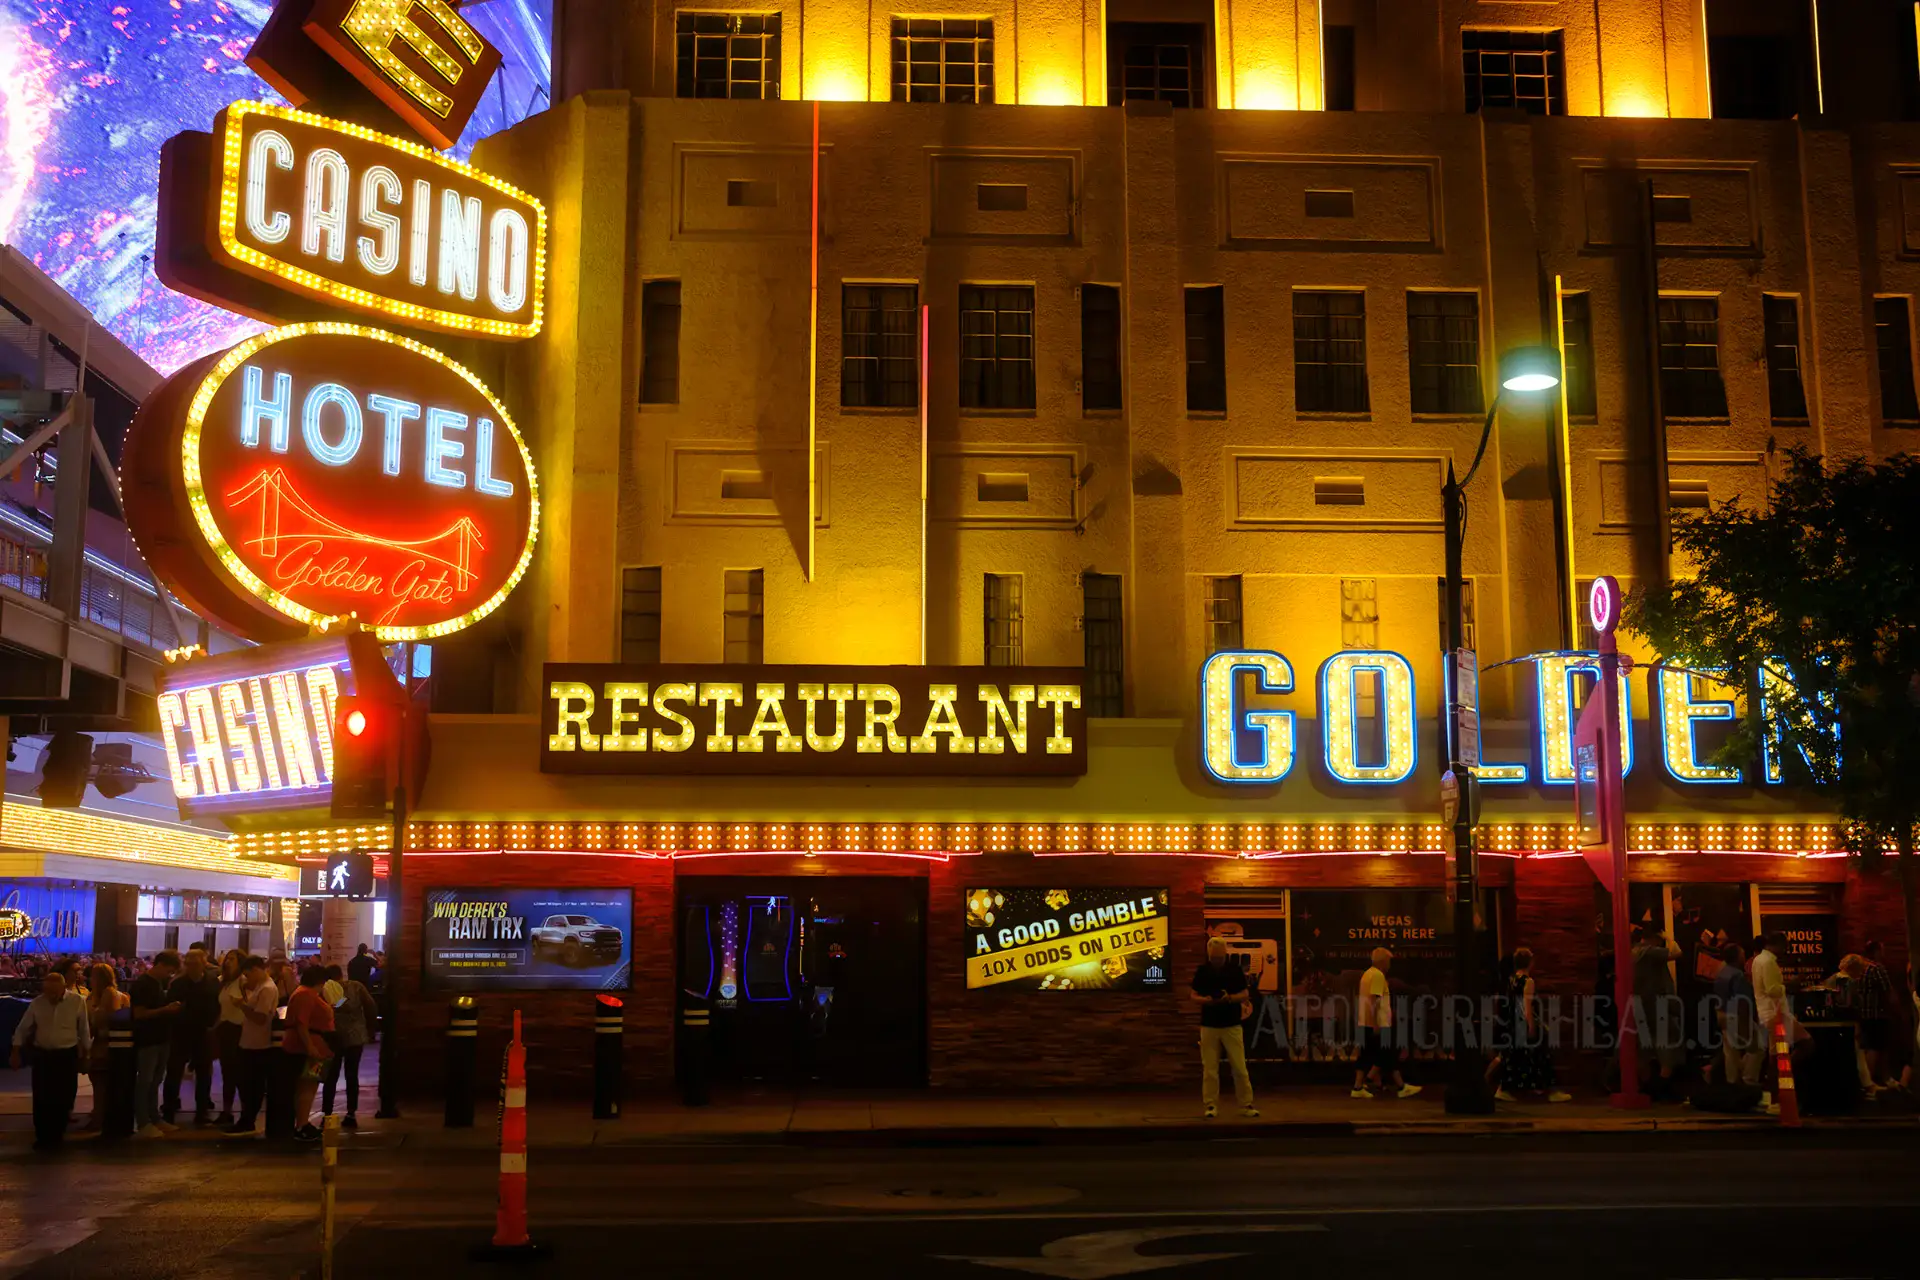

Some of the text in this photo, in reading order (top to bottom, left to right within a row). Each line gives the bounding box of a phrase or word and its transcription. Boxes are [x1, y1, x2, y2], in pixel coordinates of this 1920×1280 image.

[246, 130, 530, 313] CASINO
[240, 365, 514, 498] HOTEL
[276, 540, 453, 625] Golden Gate
[548, 681, 1082, 754] RESTAURANT
[56, 909, 79, 938] BAR
[433, 902, 507, 918] WIN DEREK'S
[1371, 915, 1412, 927] VEGAS
[449, 917, 523, 940] RAM TRX
[976, 896, 1157, 955] A GOOD GAMBLE
[1348, 928, 1436, 939] STARTS HERE
[1784, 930, 1823, 942] MOUS
[981, 927, 1156, 978] 10X ODDS ON DICE
[1786, 943, 1824, 954] INKS
